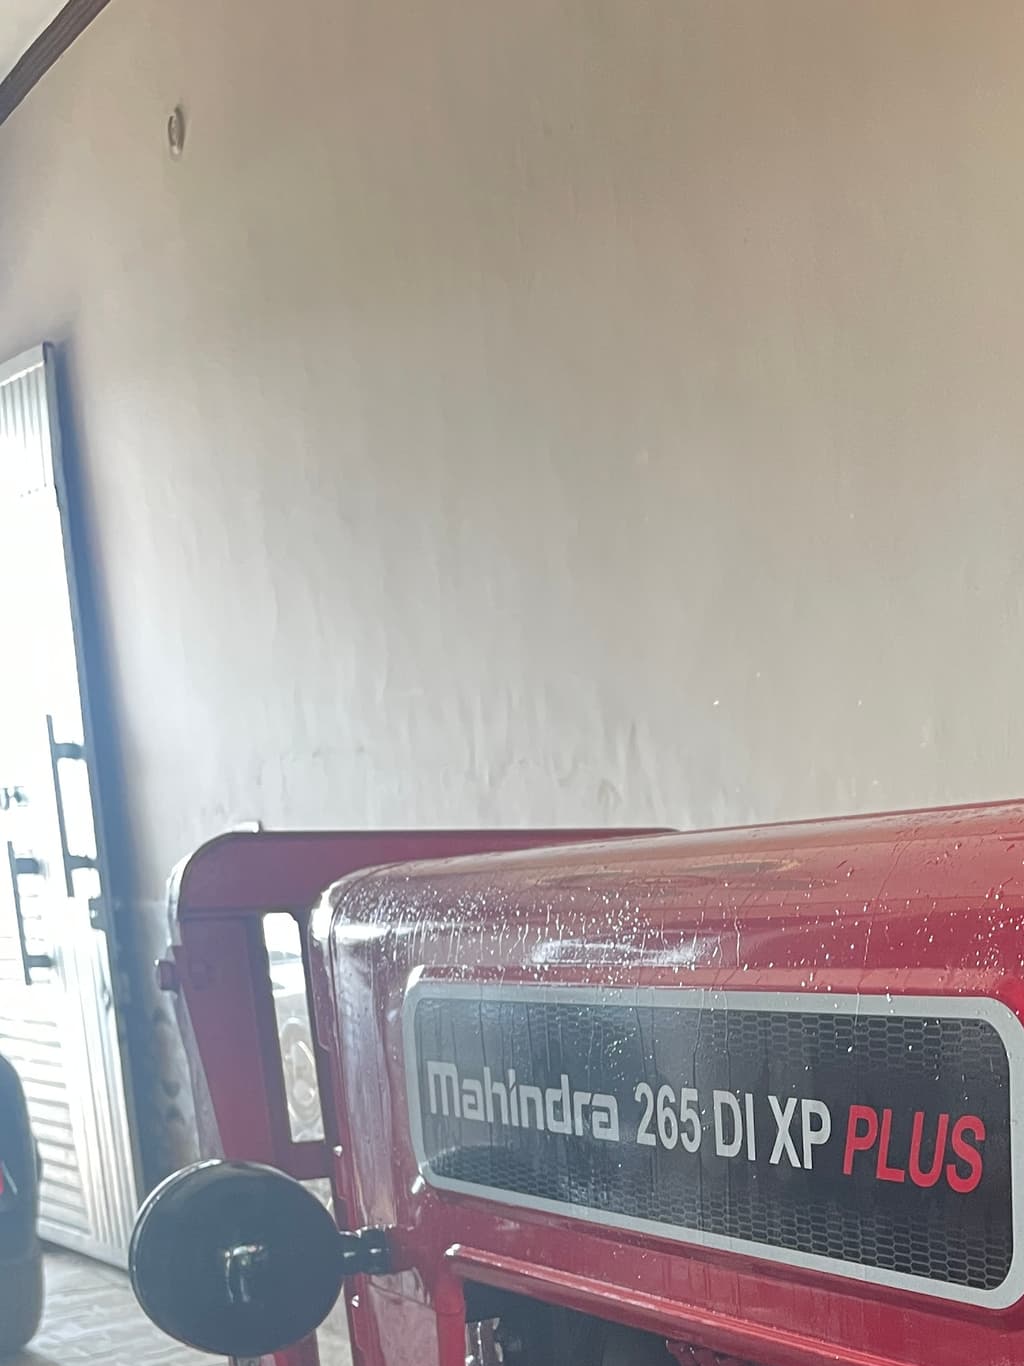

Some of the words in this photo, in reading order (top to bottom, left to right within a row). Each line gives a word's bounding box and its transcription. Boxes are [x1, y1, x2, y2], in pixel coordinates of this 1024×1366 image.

[426, 1061, 619, 1142] Mahindra
[635, 1082, 701, 1153] 265
[713, 1091, 757, 1162] DI
[768, 1097, 832, 1170] XP
[842, 1105, 986, 1193] PLUS
